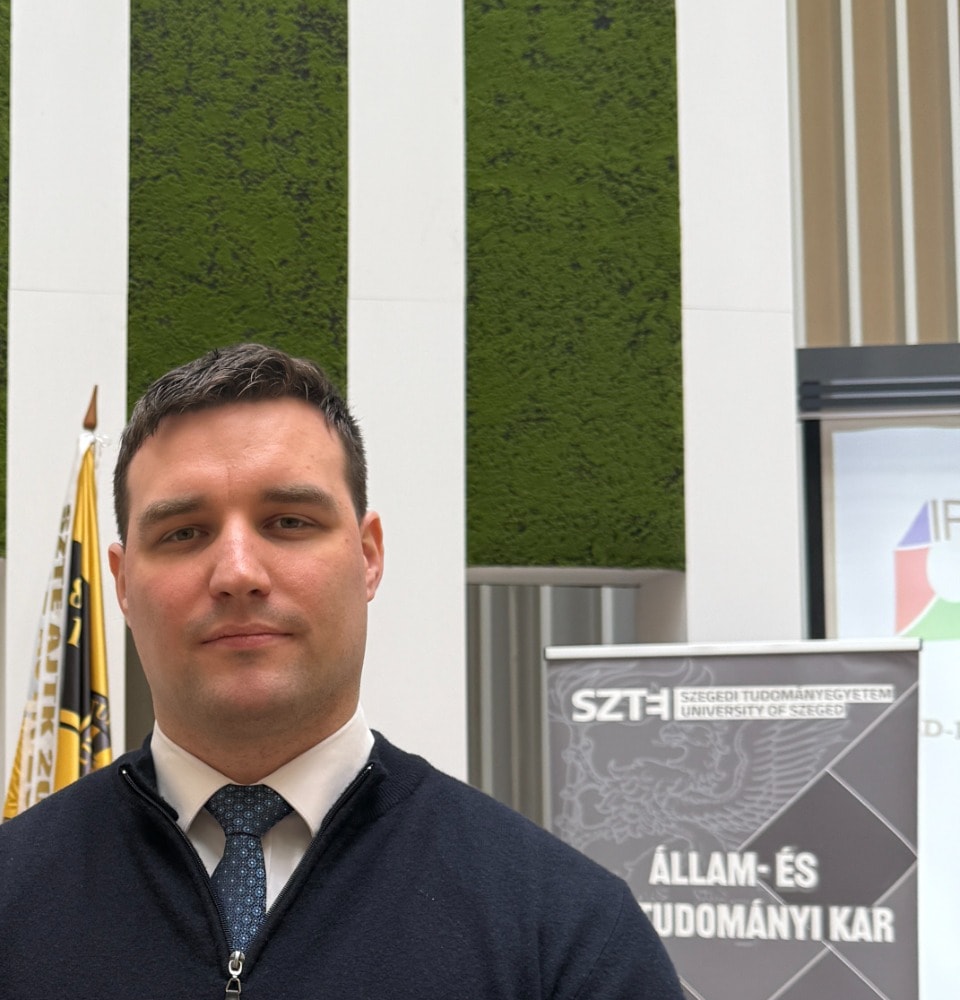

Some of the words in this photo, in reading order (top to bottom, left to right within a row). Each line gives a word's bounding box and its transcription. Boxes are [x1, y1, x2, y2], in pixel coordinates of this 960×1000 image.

[680, 690, 738, 703] SZEGEDI
[743, 685, 891, 702] TUDOMÁNYEGYETEM
[680, 705, 763, 718] UNIVERSITY
[767, 705, 786, 717] OF
[788, 704, 844, 717] SZEGED
[647, 845, 771, 887] ÁLLAM-
[775, 845, 819, 889] ÉS
[828, 905, 896, 943] KAR
